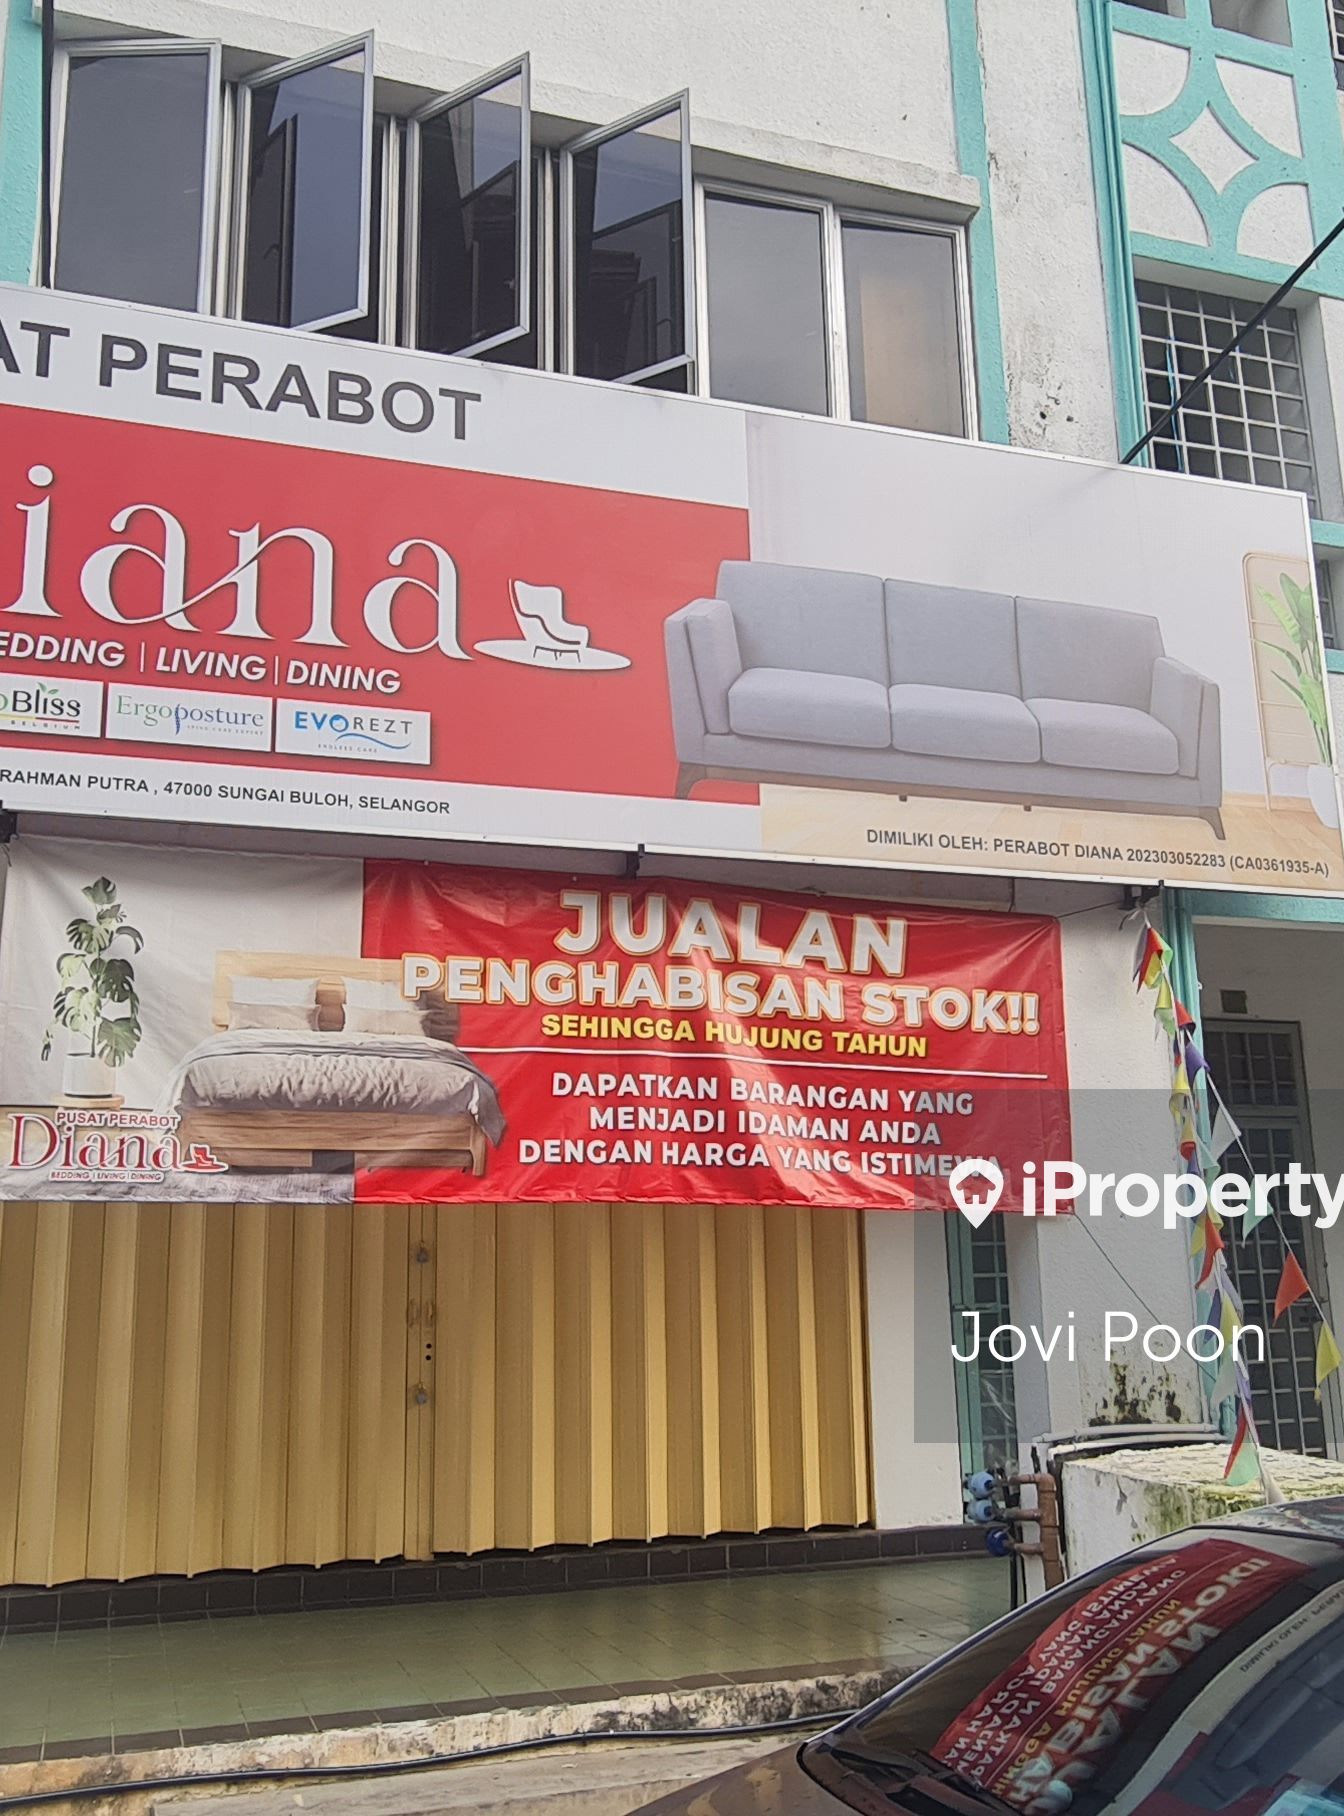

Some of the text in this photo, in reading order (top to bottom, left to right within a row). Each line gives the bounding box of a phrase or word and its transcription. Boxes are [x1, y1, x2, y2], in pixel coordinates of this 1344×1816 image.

[99, 334, 482, 441] PERABOT
[156, 646, 268, 681] LIVING
[286, 660, 402, 695] DINING
[116, 694, 264, 735] Ergoposture
[295, 711, 413, 735] EVOREZT
[0, 769, 81, 788] RAHMAN
[87, 775, 149, 793] PUTRA
[163, 781, 213, 798] 47000
[217, 785, 285, 803] SUNGAI
[290, 791, 354, 809] BULOH,
[358, 796, 450, 815] SELANGOR
[866, 828, 1330, 878] DIMILIKI OLEH: PERABOT DIANA 202303052283 (CA0361935-A)
[555, 889, 908, 976] JUALAN
[401, 953, 1041, 1036] PENGHABISAN STOK!!
[541, 1014, 927, 1058] SEHINGGA HUJUNG TAHUN
[552, 1071, 974, 1116] DAPATKAN BARANGAN YANG
[56, 1112, 179, 1127] PUSAT PERABOT
[590, 1106, 941, 1146] MENJADI IDAMAN ANDA
[8, 1114, 183, 1171] Diana
[519, 1138, 654, 1166] DENGAN
[662, 1144, 769, 1169] HARGA
[776, 1149, 853, 1175] YANG
